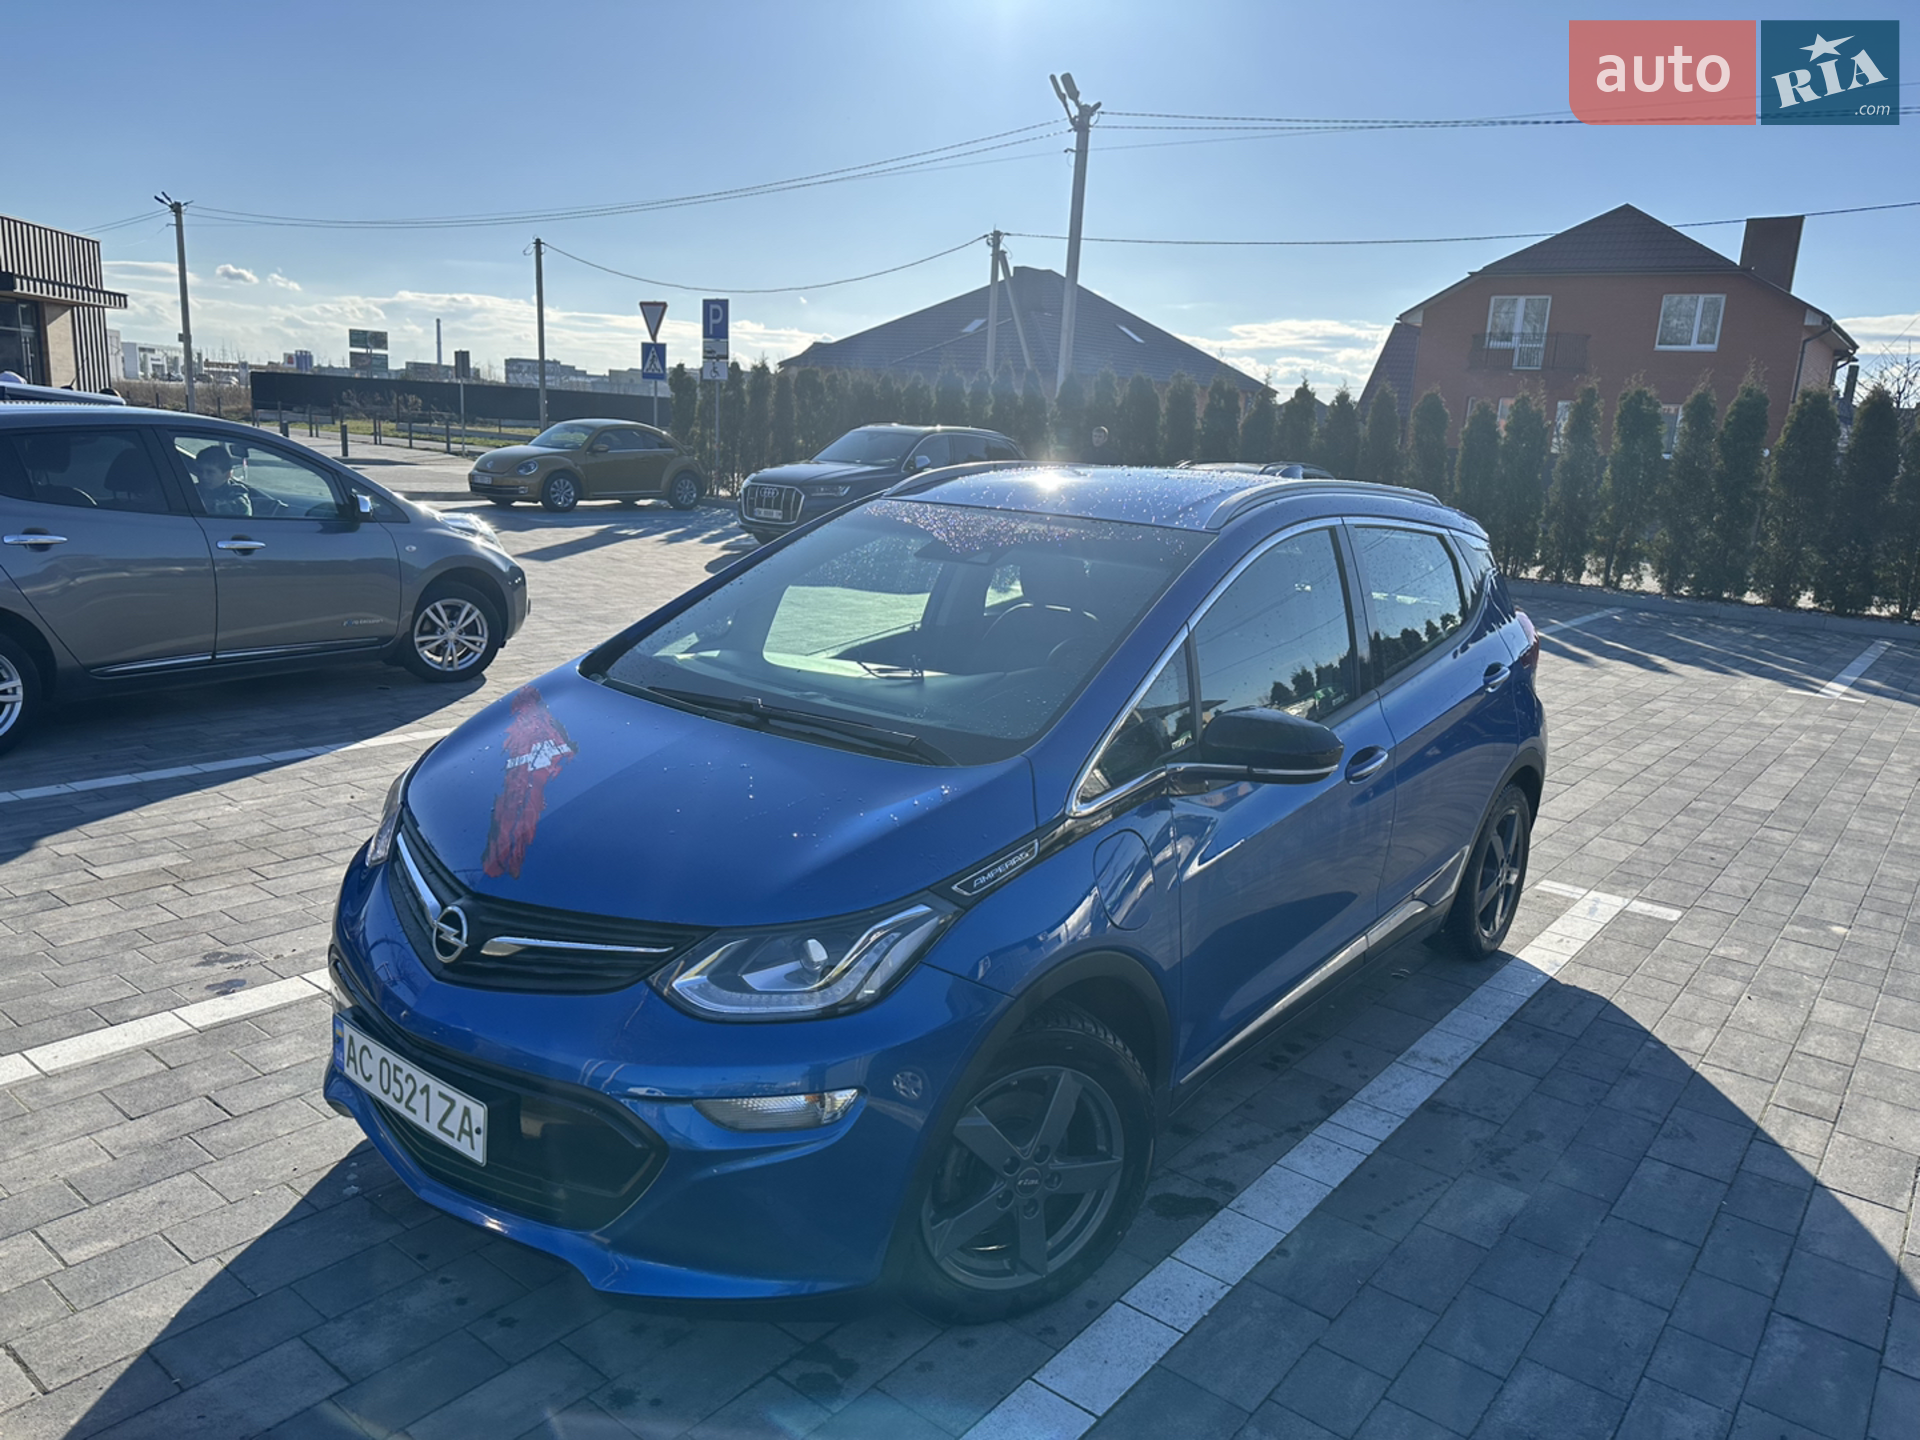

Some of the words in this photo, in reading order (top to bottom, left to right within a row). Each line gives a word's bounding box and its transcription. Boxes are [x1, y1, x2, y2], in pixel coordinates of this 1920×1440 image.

[709, 304, 723, 335] P
[346, 1034, 373, 1082] AC
[379, 1056, 430, 1123] 0521
[437, 1090, 476, 1151] ZA
